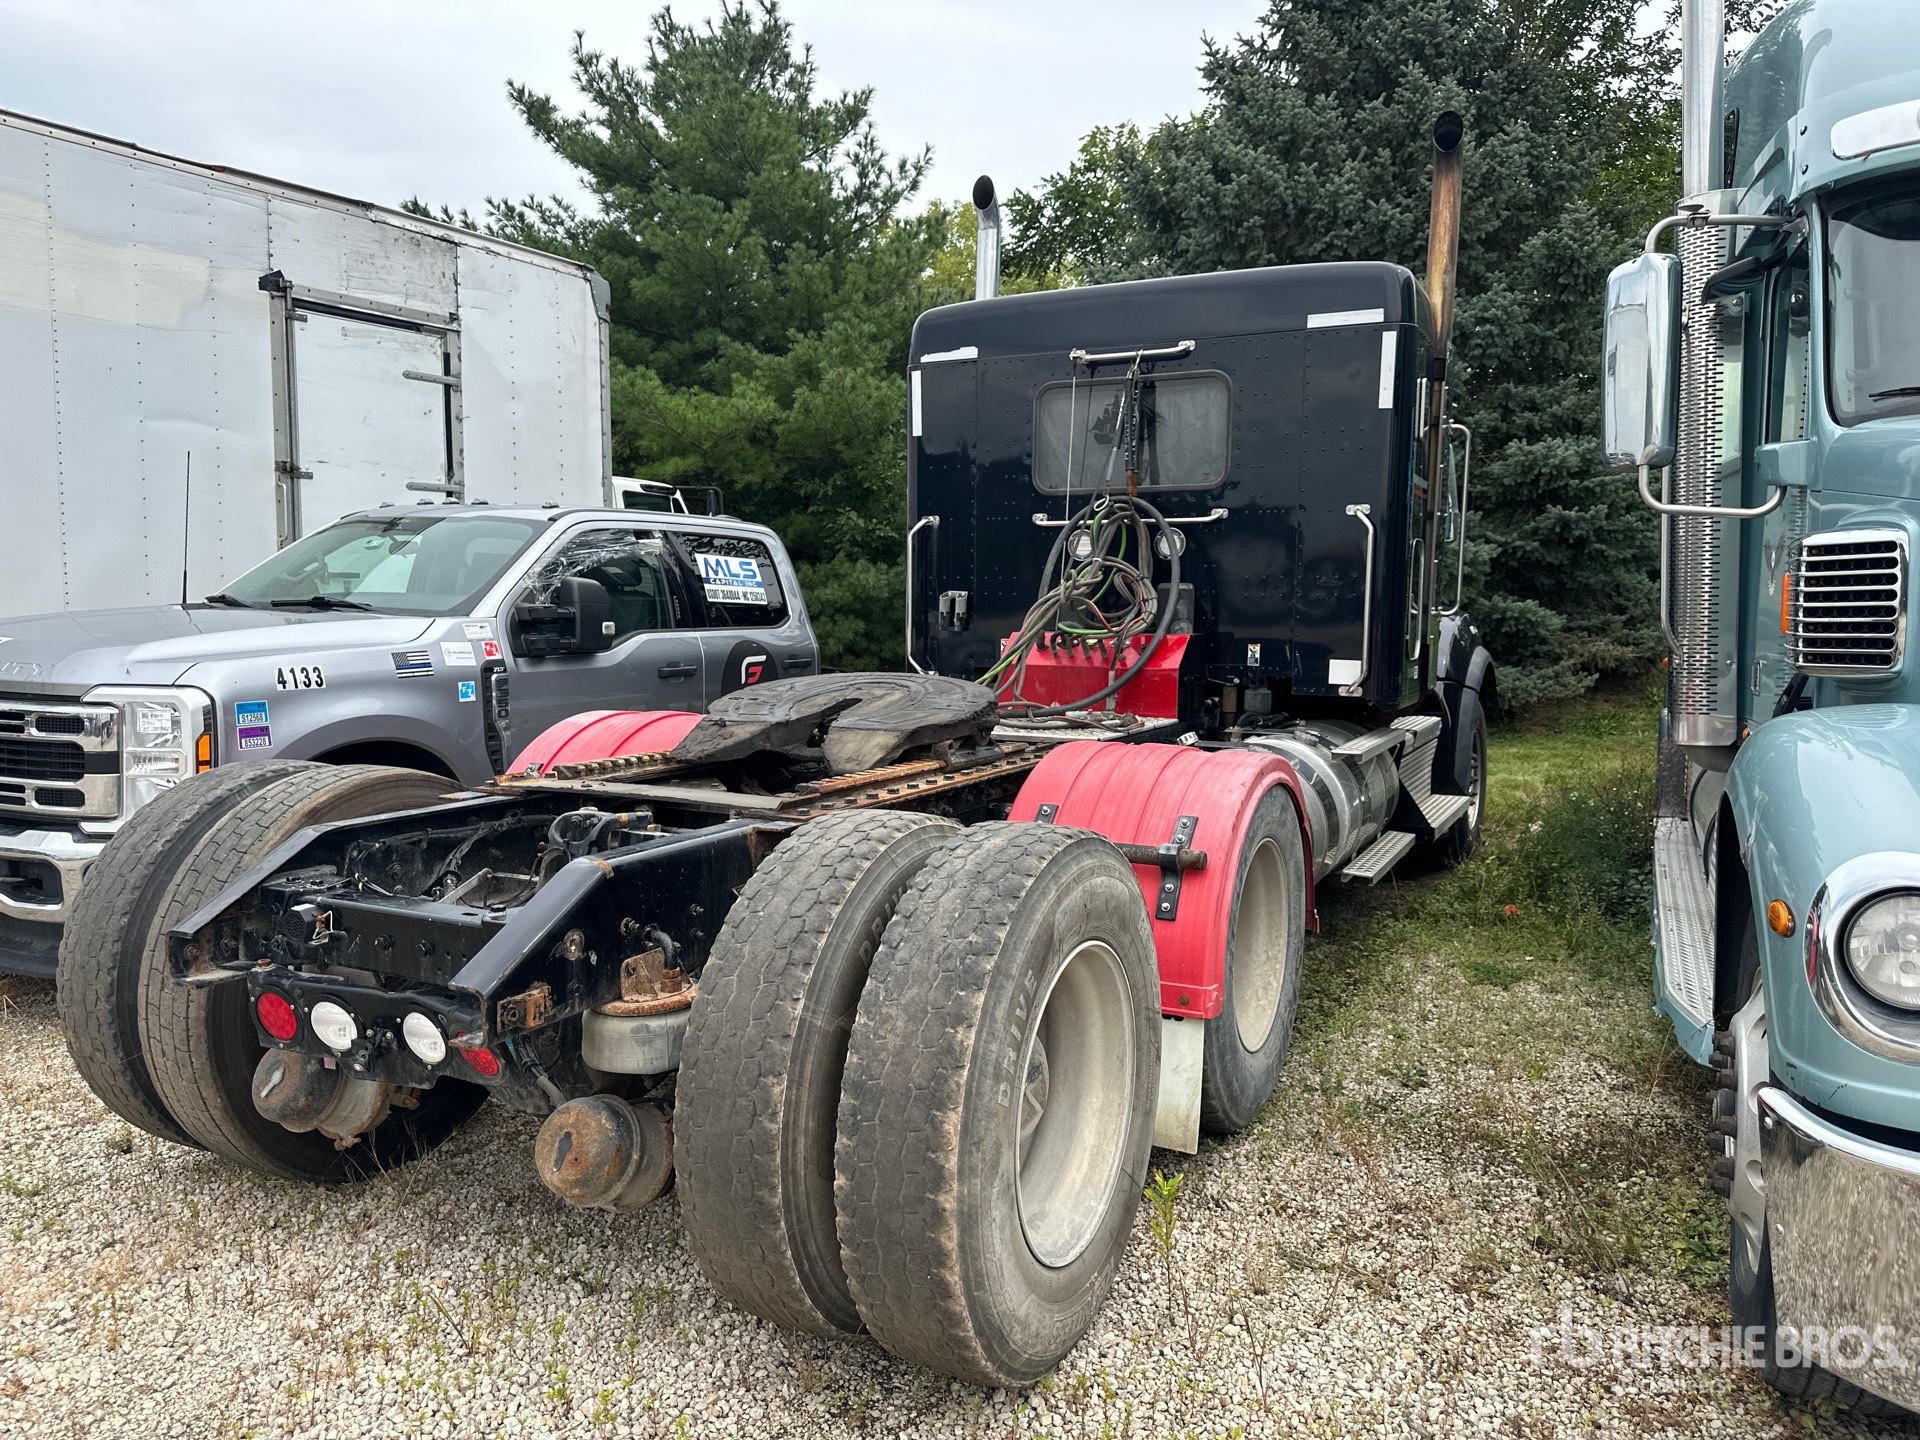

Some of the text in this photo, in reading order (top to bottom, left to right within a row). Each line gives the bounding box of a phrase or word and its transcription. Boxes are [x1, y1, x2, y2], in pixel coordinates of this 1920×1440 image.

[703, 557, 757, 580] MLS
[709, 578, 742, 587] CAPITAL
[277, 666, 324, 690] 4133
[998, 967, 1038, 1108] DRIVE
